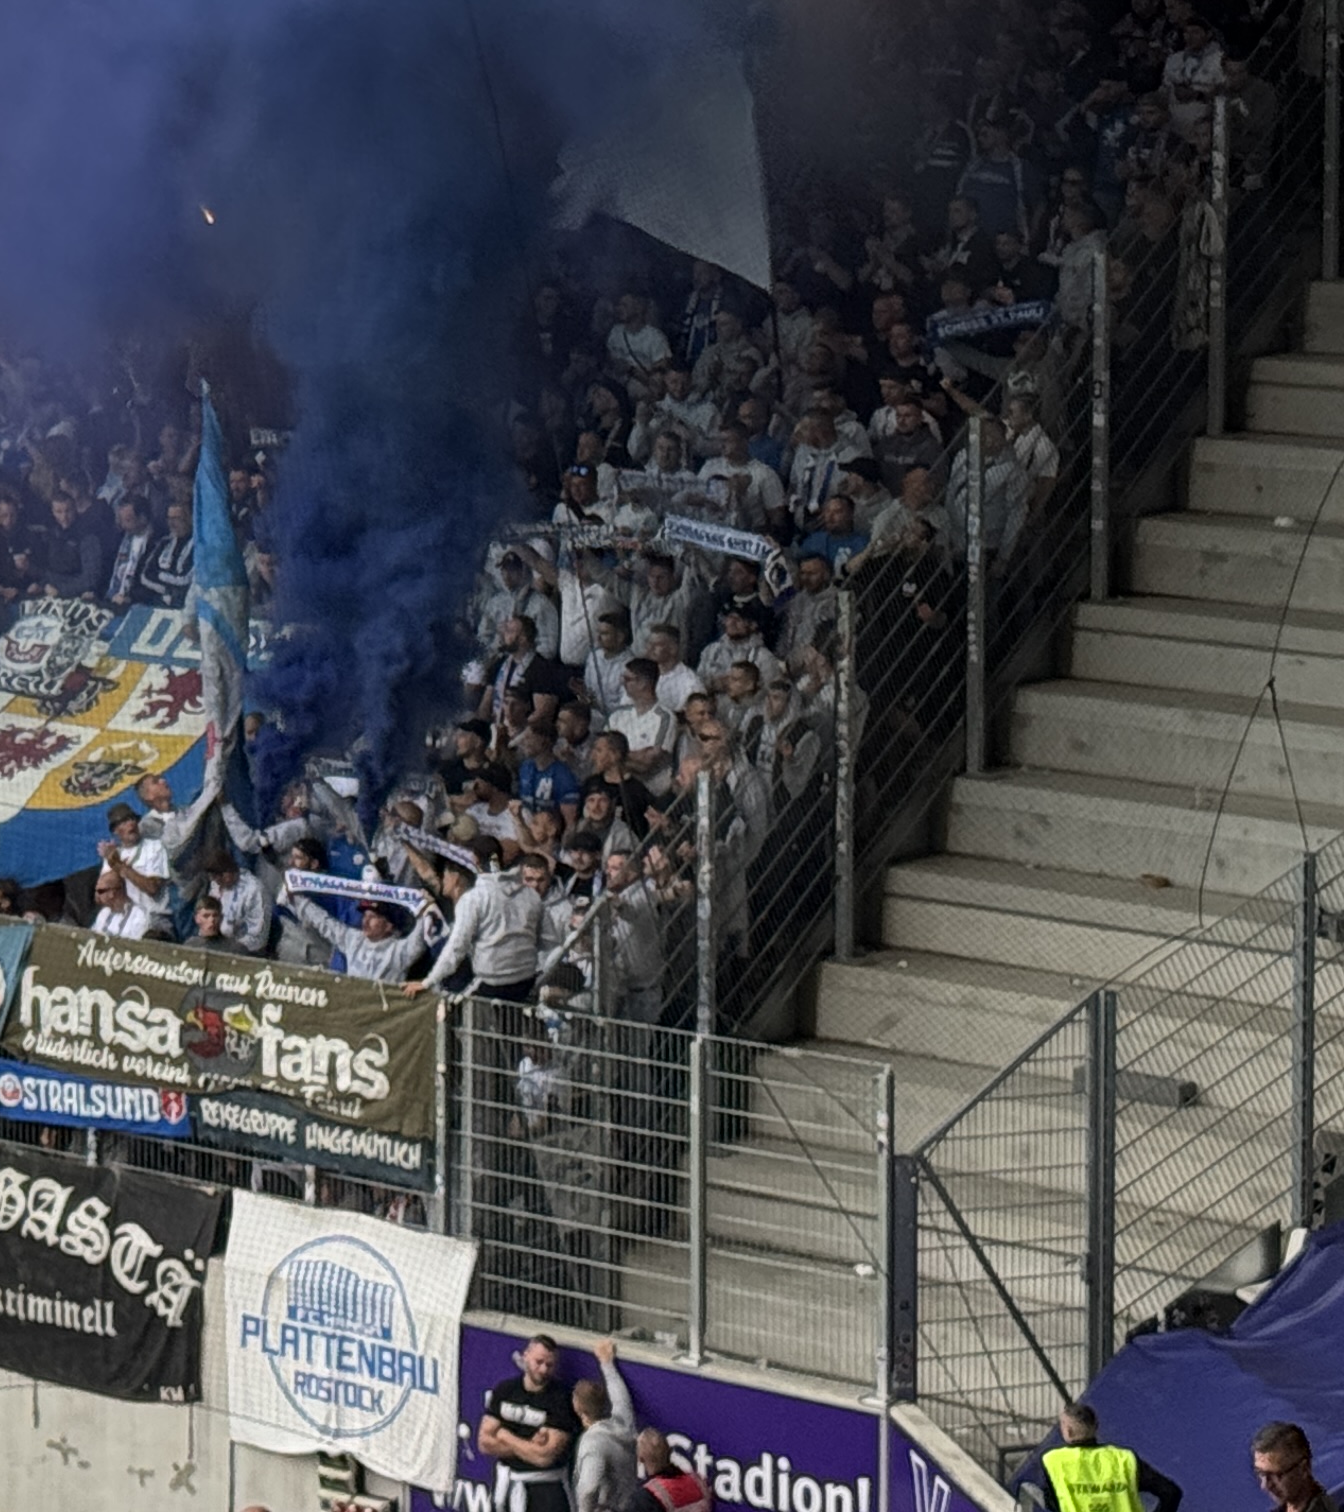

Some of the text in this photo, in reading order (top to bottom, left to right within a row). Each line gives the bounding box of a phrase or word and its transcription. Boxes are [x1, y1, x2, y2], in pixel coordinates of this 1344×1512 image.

[76, 938, 329, 1008] Auferstanden aus Ruinen
[19, 964, 392, 1101] hansa fans
[21, 1076, 161, 1124] STRALSUND
[239, 1312, 440, 1396] PLATTENBAU
[293, 1368, 386, 1416] ROSTOCK
